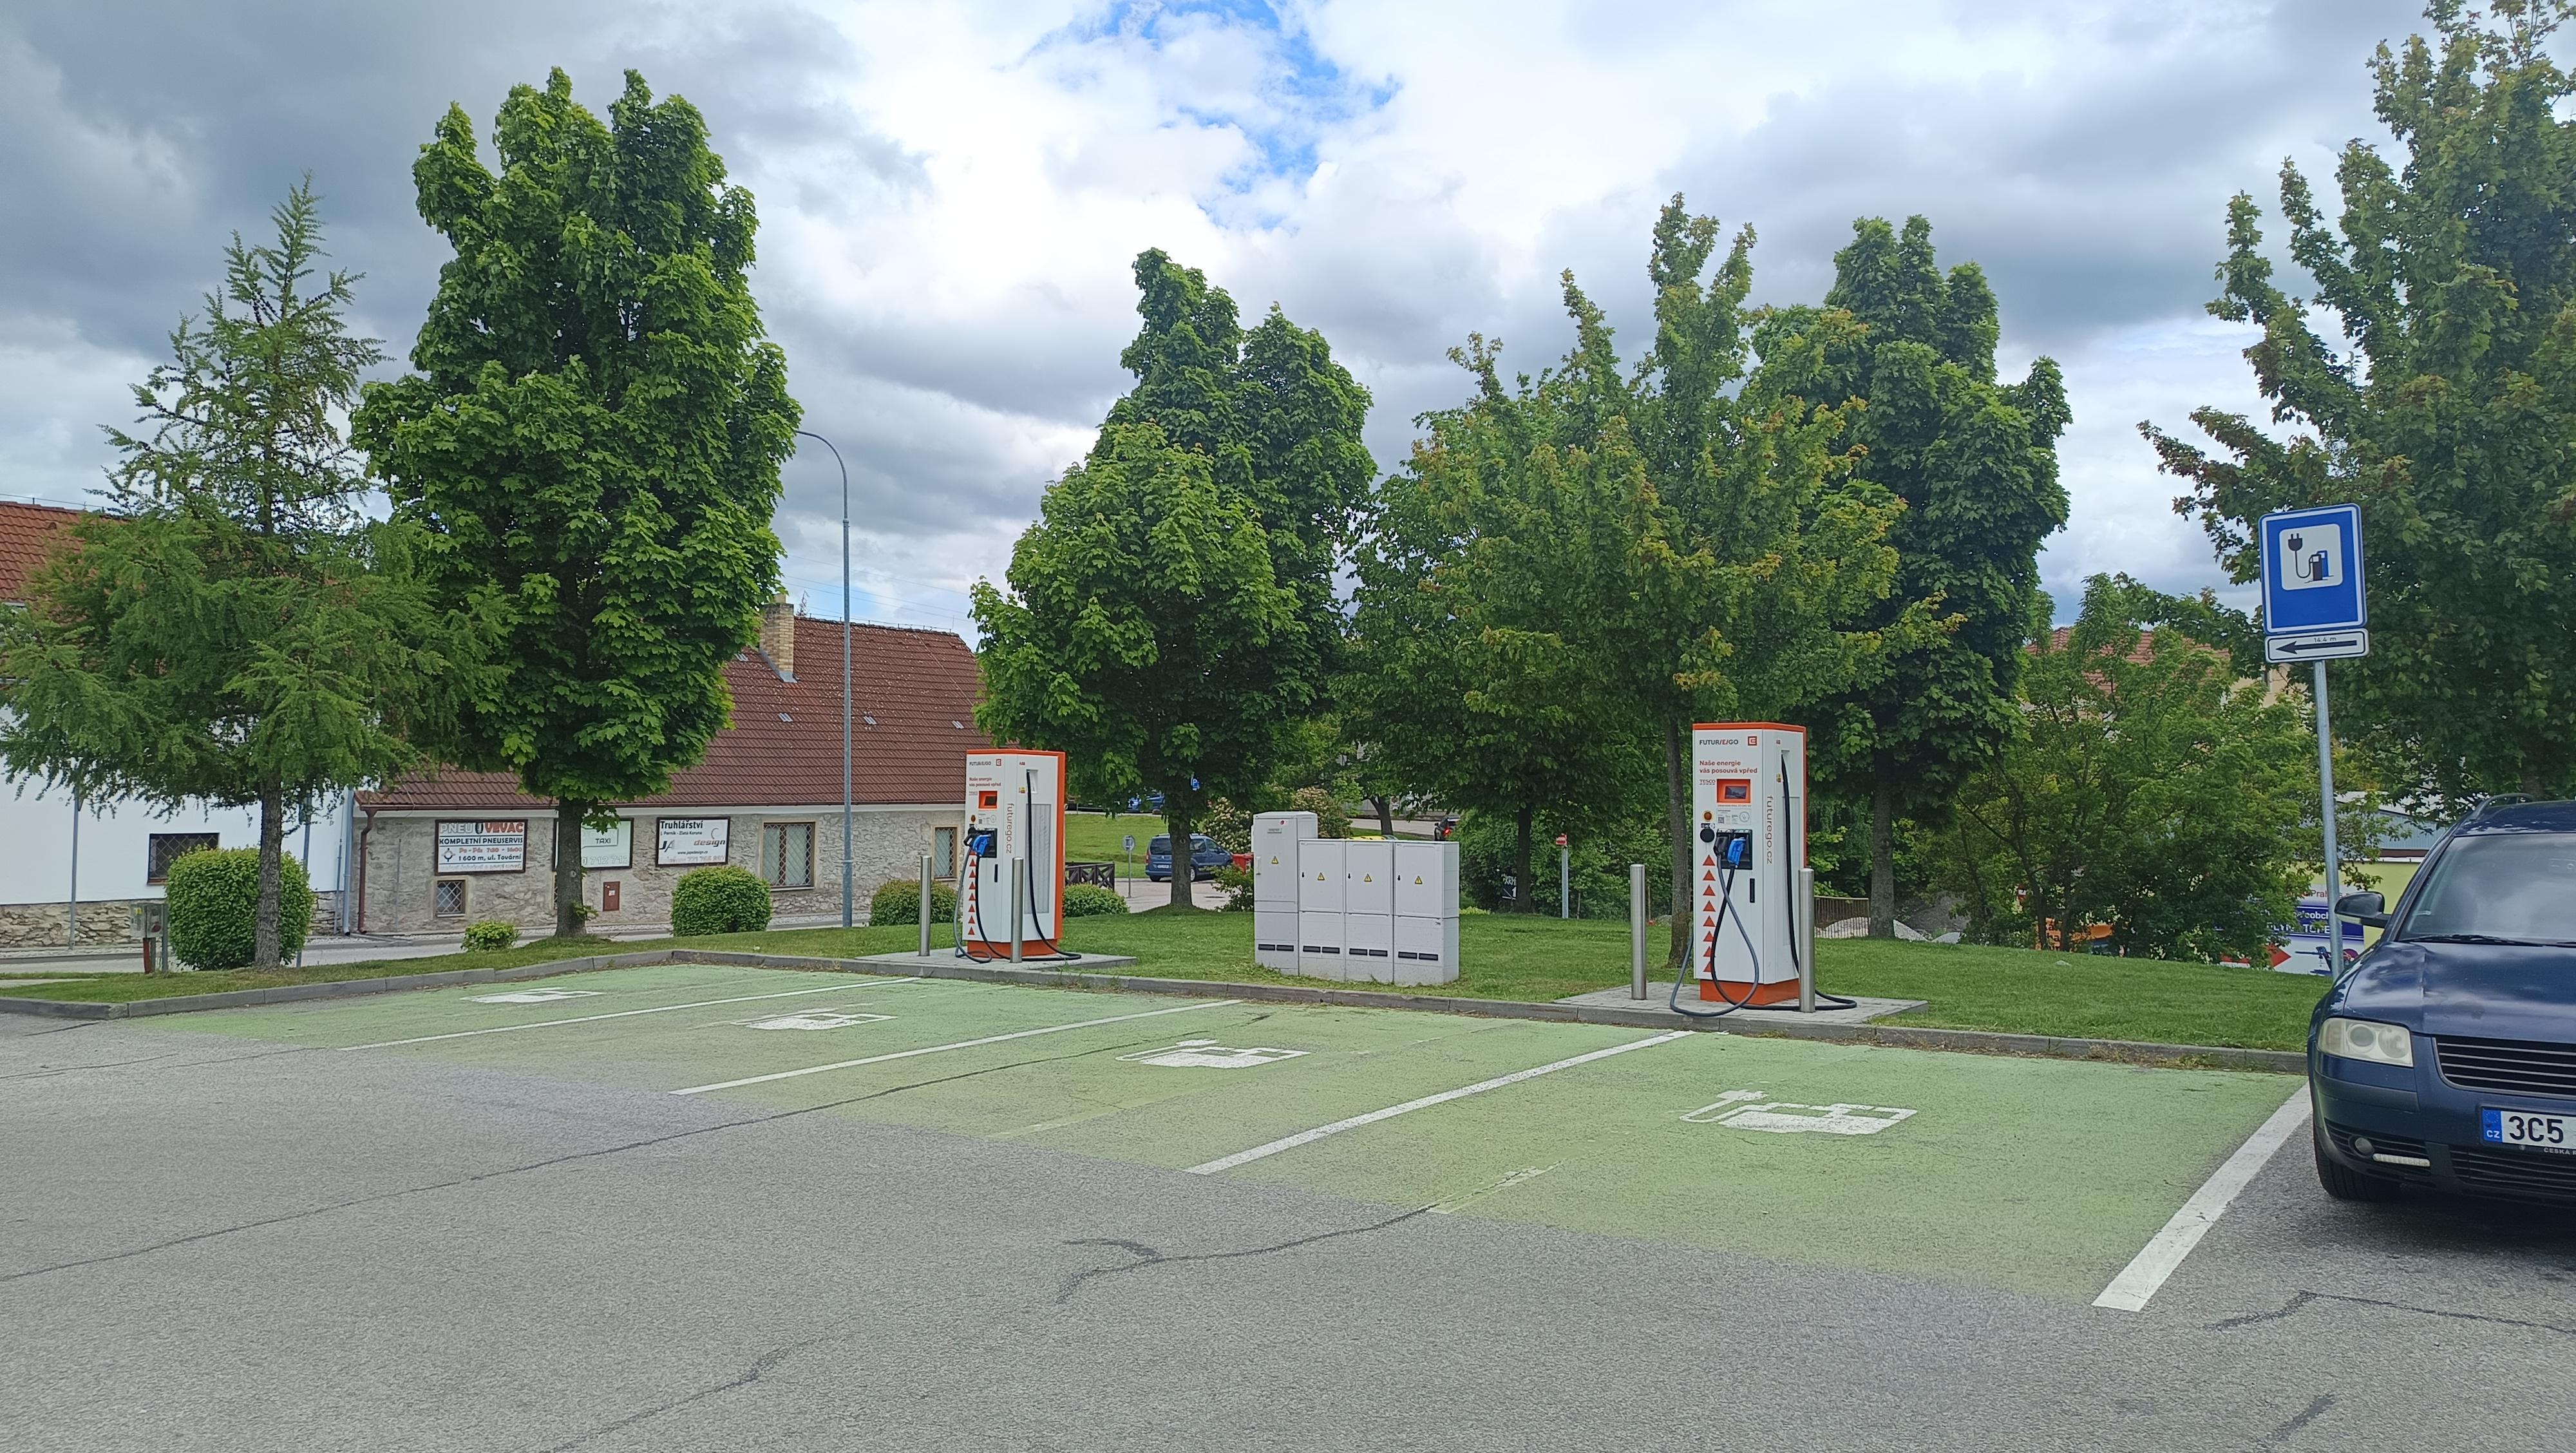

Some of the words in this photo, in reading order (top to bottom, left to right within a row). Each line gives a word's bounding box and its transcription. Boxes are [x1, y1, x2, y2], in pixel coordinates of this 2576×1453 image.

[660, 820, 703, 829] Truhlářství
[1005, 803, 1015, 854] futurego.cz
[1765, 795, 1774, 864] futurego.cz
[2486, 1130, 2500, 1139] CZ
[2508, 1116, 2564, 1144] 3C5
